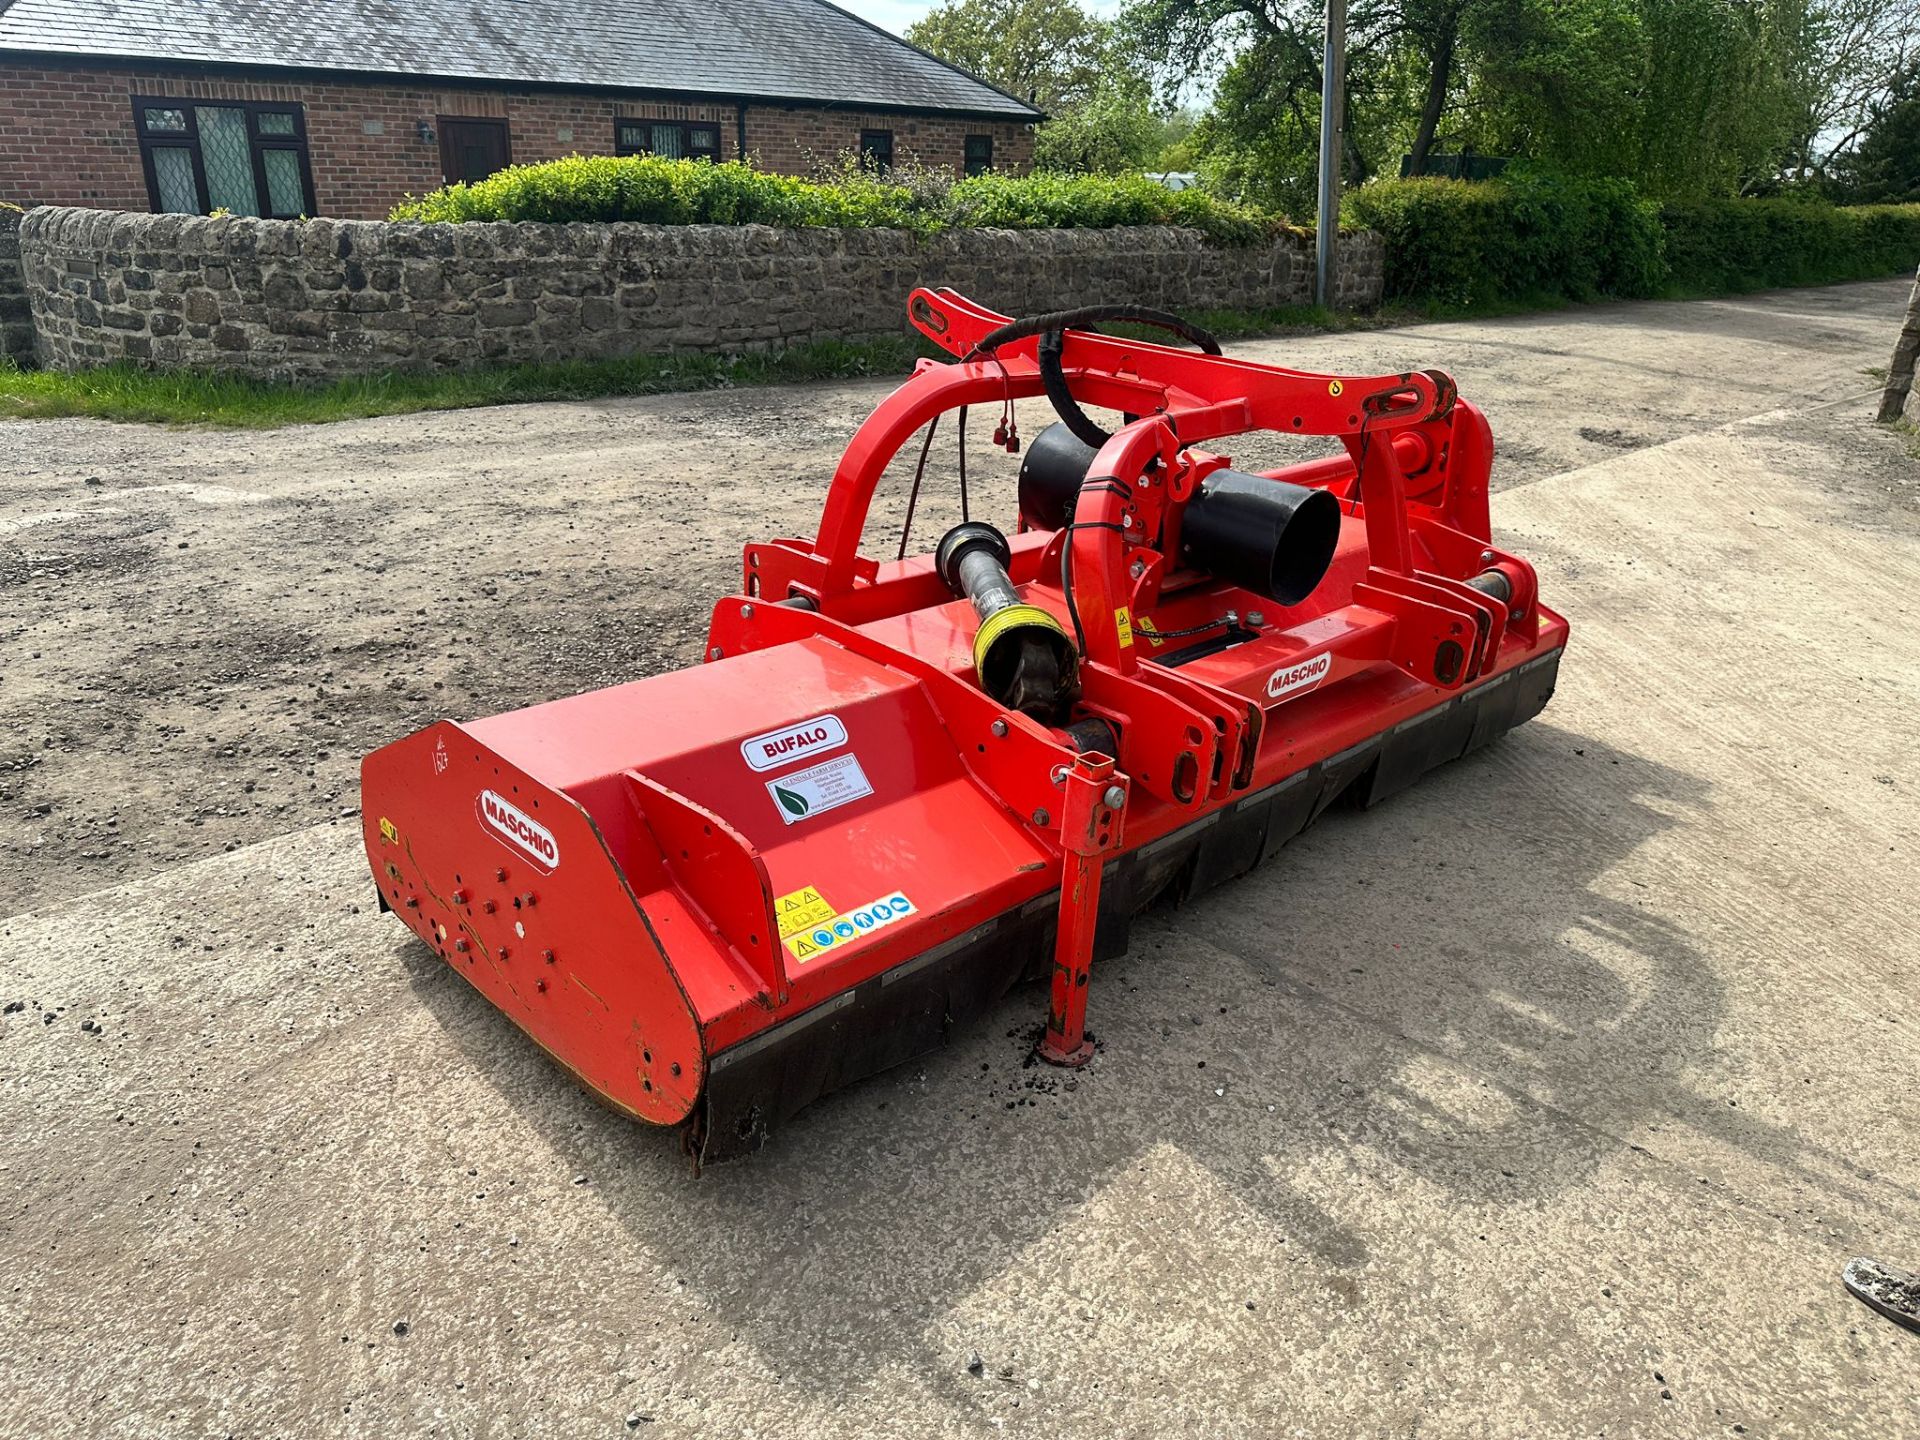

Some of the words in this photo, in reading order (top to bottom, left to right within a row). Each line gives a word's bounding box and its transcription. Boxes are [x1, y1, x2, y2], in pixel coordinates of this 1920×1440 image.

[1270, 658, 1328, 692] MASCHIO
[762, 727, 828, 758] BUFALO
[781, 771, 812, 787] GLENDALE
[811, 765, 829, 777] FARM
[484, 797, 555, 860] MASCHIO
